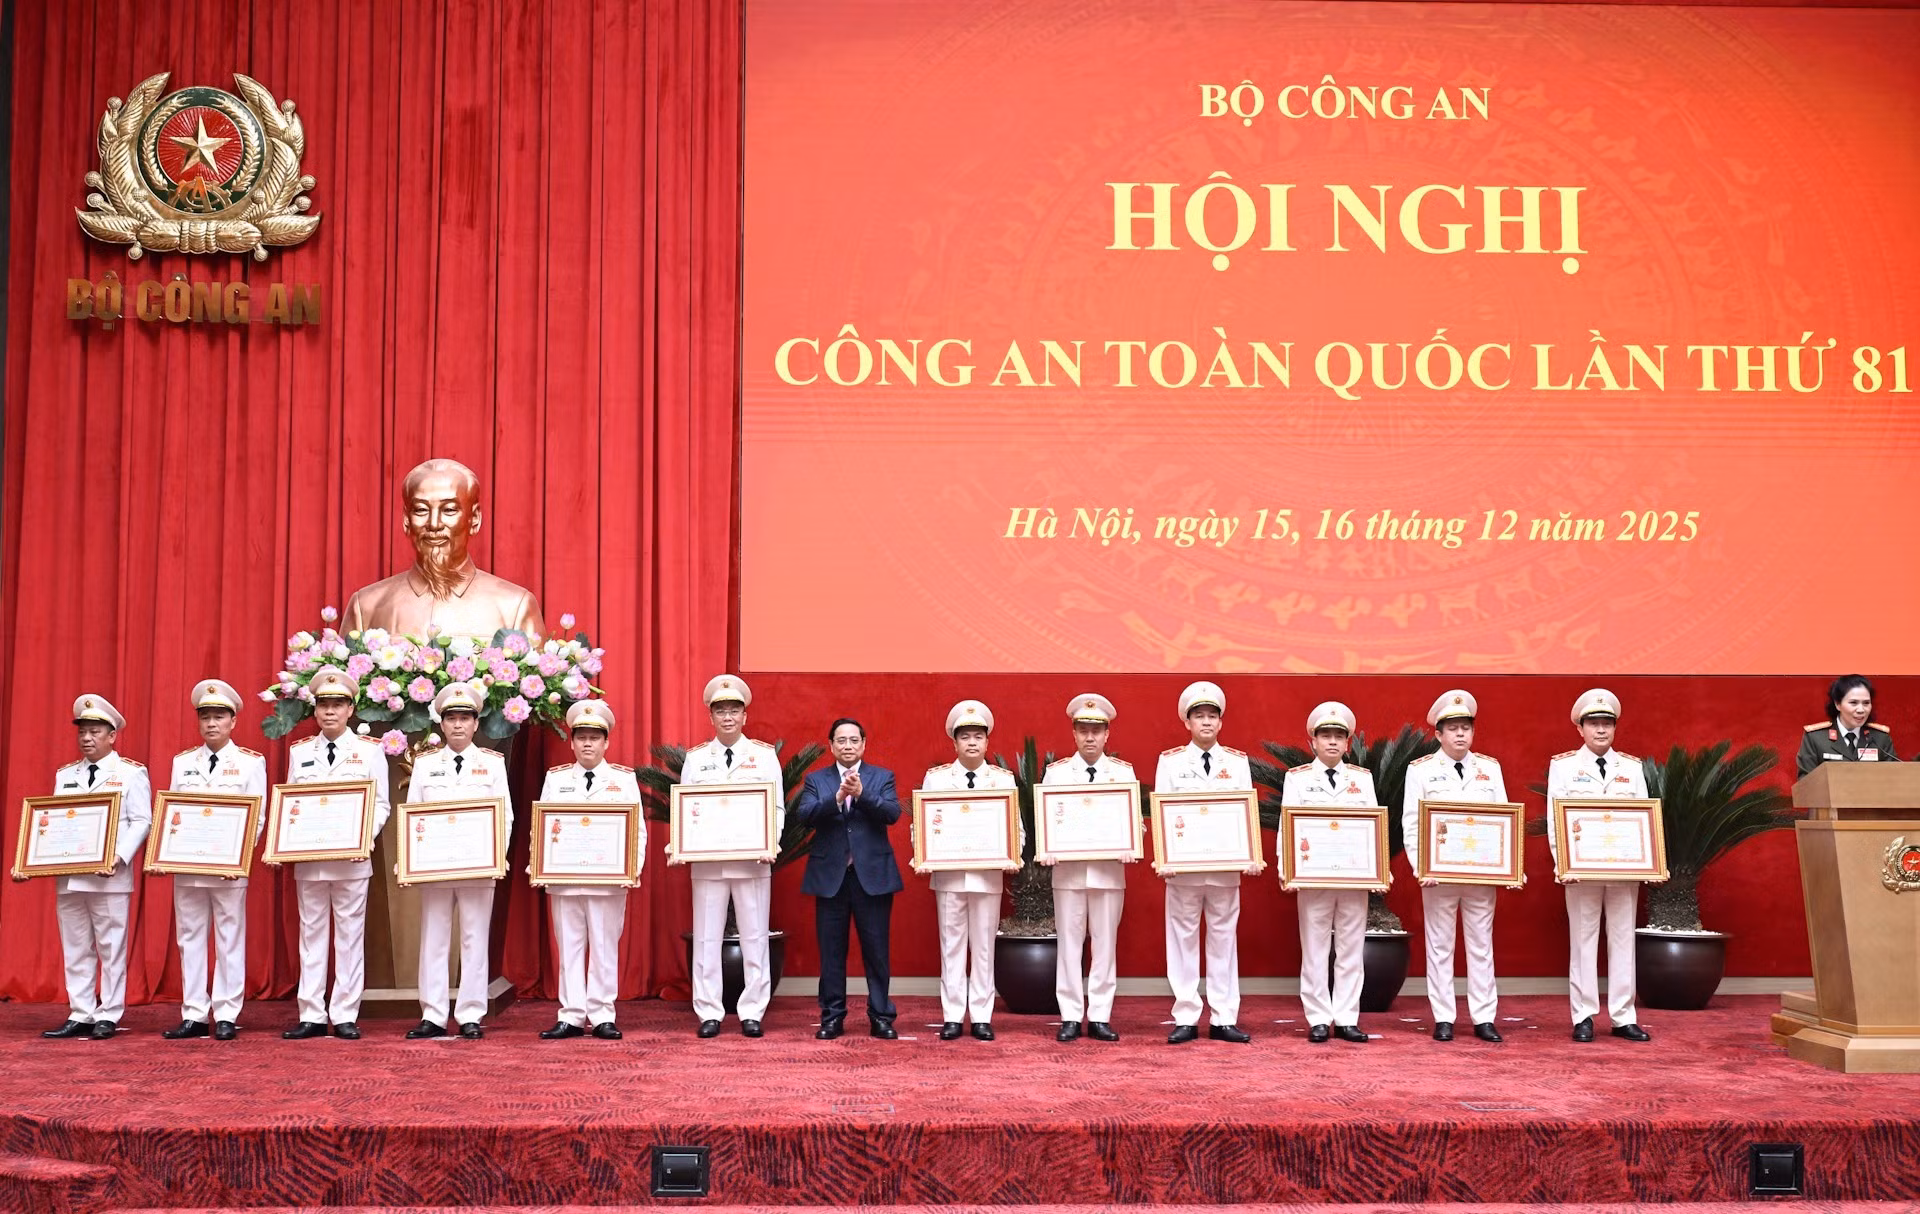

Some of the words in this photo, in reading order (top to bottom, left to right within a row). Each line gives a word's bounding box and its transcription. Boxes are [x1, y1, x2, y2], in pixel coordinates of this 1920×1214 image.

[1199, 79, 1265, 127] BỘ
[1277, 74, 1416, 120] CÔNG
[1427, 87, 1491, 120] AN
[1106, 170, 1297, 272] HỘI
[1325, 184, 1588, 275] NGHỊ
[67, 270, 122, 330] BỘ
[136, 272, 250, 323] CÔNG
[264, 282, 320, 325] AN
[774, 323, 977, 387] CÔNG
[989, 339, 1086, 387] AN
[1104, 326, 1295, 389] TOÀN
[1314, 328, 1511, 401] QUỐC
[1530, 329, 1669, 392] LẦN
[1686, 331, 1837, 393] THỨ
[1852, 346, 1913, 393] 81
[1002, 507, 1059, 539] Hà
[1067, 507, 1142, 547] Nội,
[1153, 508, 1240, 549] ngày
[1250, 508, 1301, 546] 15,
[1314, 508, 1355, 541] 16
[1365, 509, 1467, 549] tháng
[1477, 509, 1519, 541] 12
[1528, 511, 1605, 541] năm
[1615, 510, 1700, 542] 2025
